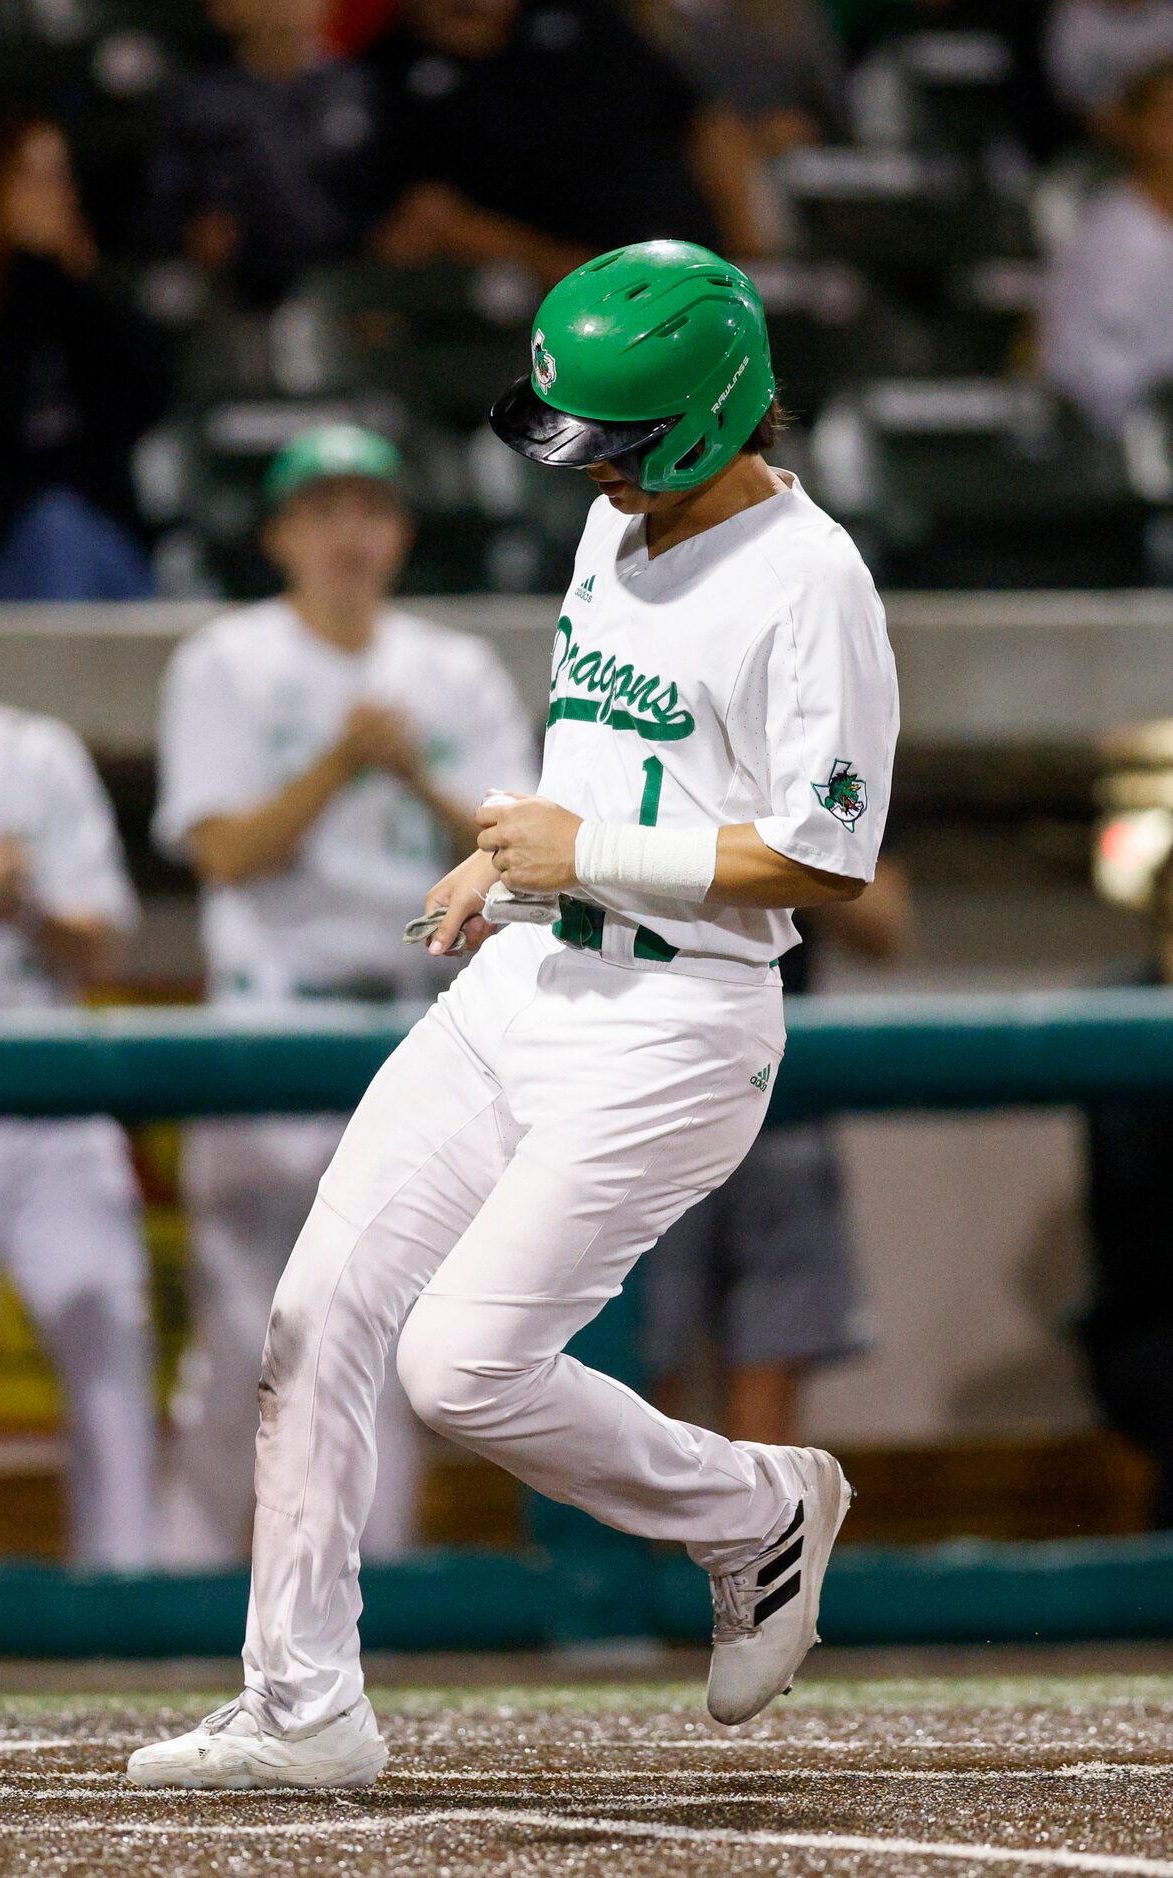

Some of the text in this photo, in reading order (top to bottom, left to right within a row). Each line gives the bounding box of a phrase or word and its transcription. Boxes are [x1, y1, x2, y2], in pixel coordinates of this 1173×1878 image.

[711, 355, 750, 414] RAWLINGS
[550, 615, 695, 726] Dragons
[639, 755, 663, 828] 1
